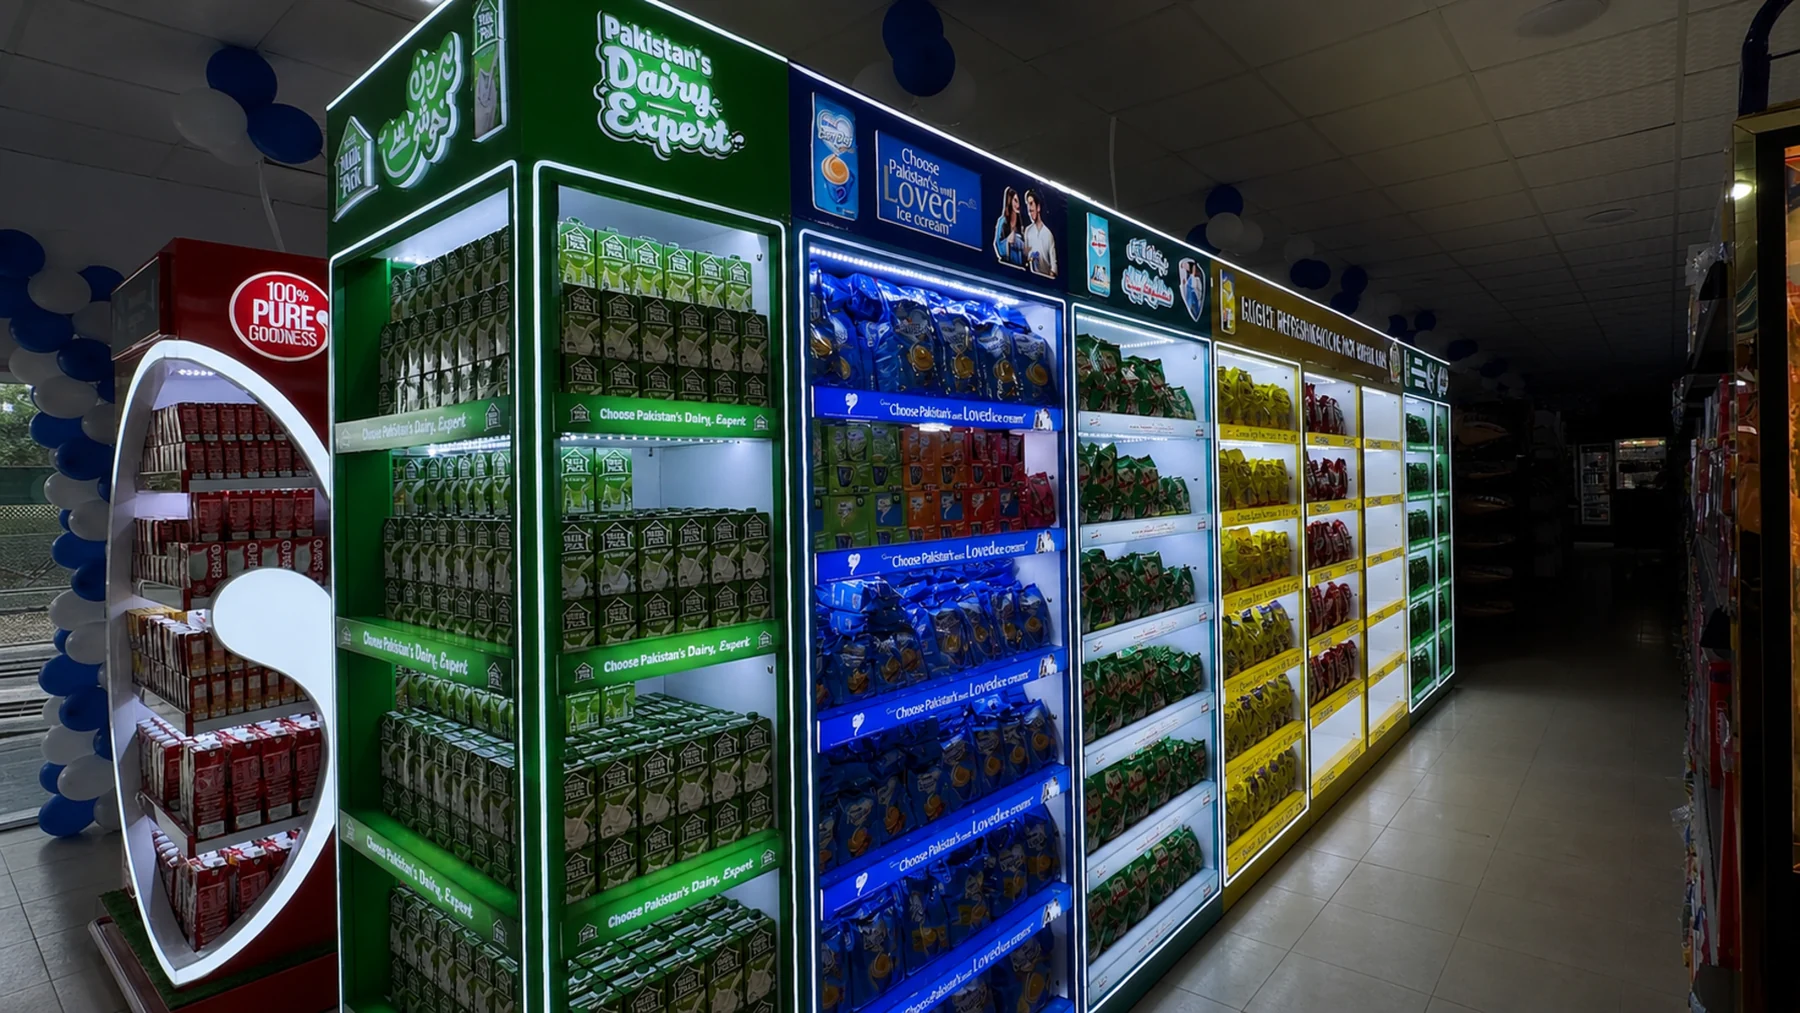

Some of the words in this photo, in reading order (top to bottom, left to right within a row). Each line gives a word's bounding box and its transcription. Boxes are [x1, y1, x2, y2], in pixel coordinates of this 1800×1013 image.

[604, 14, 713, 77] Pakistan's
[604, 45, 719, 118] Dairy
[605, 92, 731, 153] Expert
[901, 148, 939, 176] Choose
[884, 165, 956, 224] Loved
[266, 281, 310, 303] 100%
[253, 298, 316, 331] PURE
[249, 325, 318, 347] GOODNESS
[600, 408, 635, 420] Choose
[636, 409, 683, 423] Pakistan's
[889, 402, 919, 418] Choose
[963, 406, 992, 423] Loved
[892, 553, 922, 568] Choose
[965, 541, 995, 559] Loved
[604, 659, 639, 674] Choose
[640, 649, 687, 667] Pakistan's
[969, 674, 998, 697] Loved
[899, 850, 928, 872] Choose
[972, 808, 1000, 836] Loved
[607, 907, 643, 929] Choose
[644, 886, 690, 913] Pakistan's
